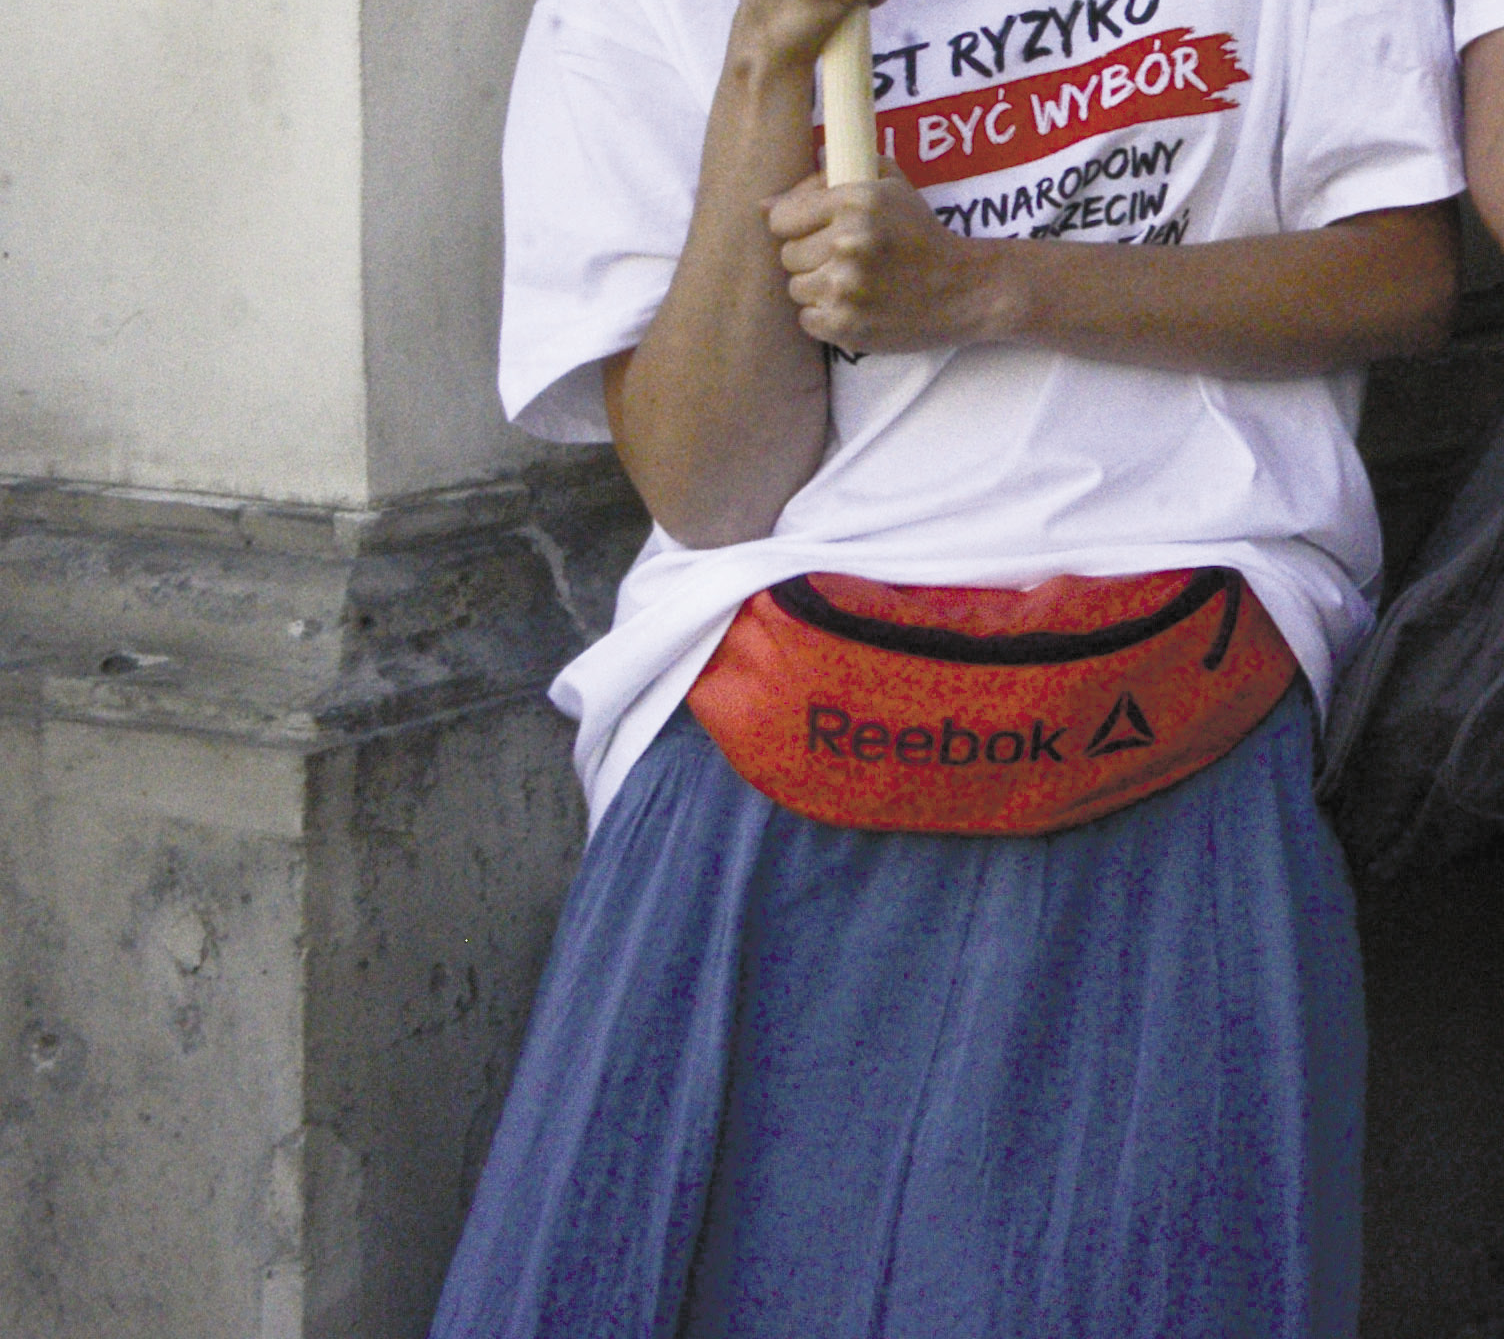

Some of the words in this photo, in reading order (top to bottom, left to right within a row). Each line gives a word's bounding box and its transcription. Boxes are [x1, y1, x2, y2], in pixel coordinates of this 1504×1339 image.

[918, 88, 1015, 163] BYĆ
[1031, 40, 1207, 136] WYBÓR
[806, 705, 1069, 767] Reebok
